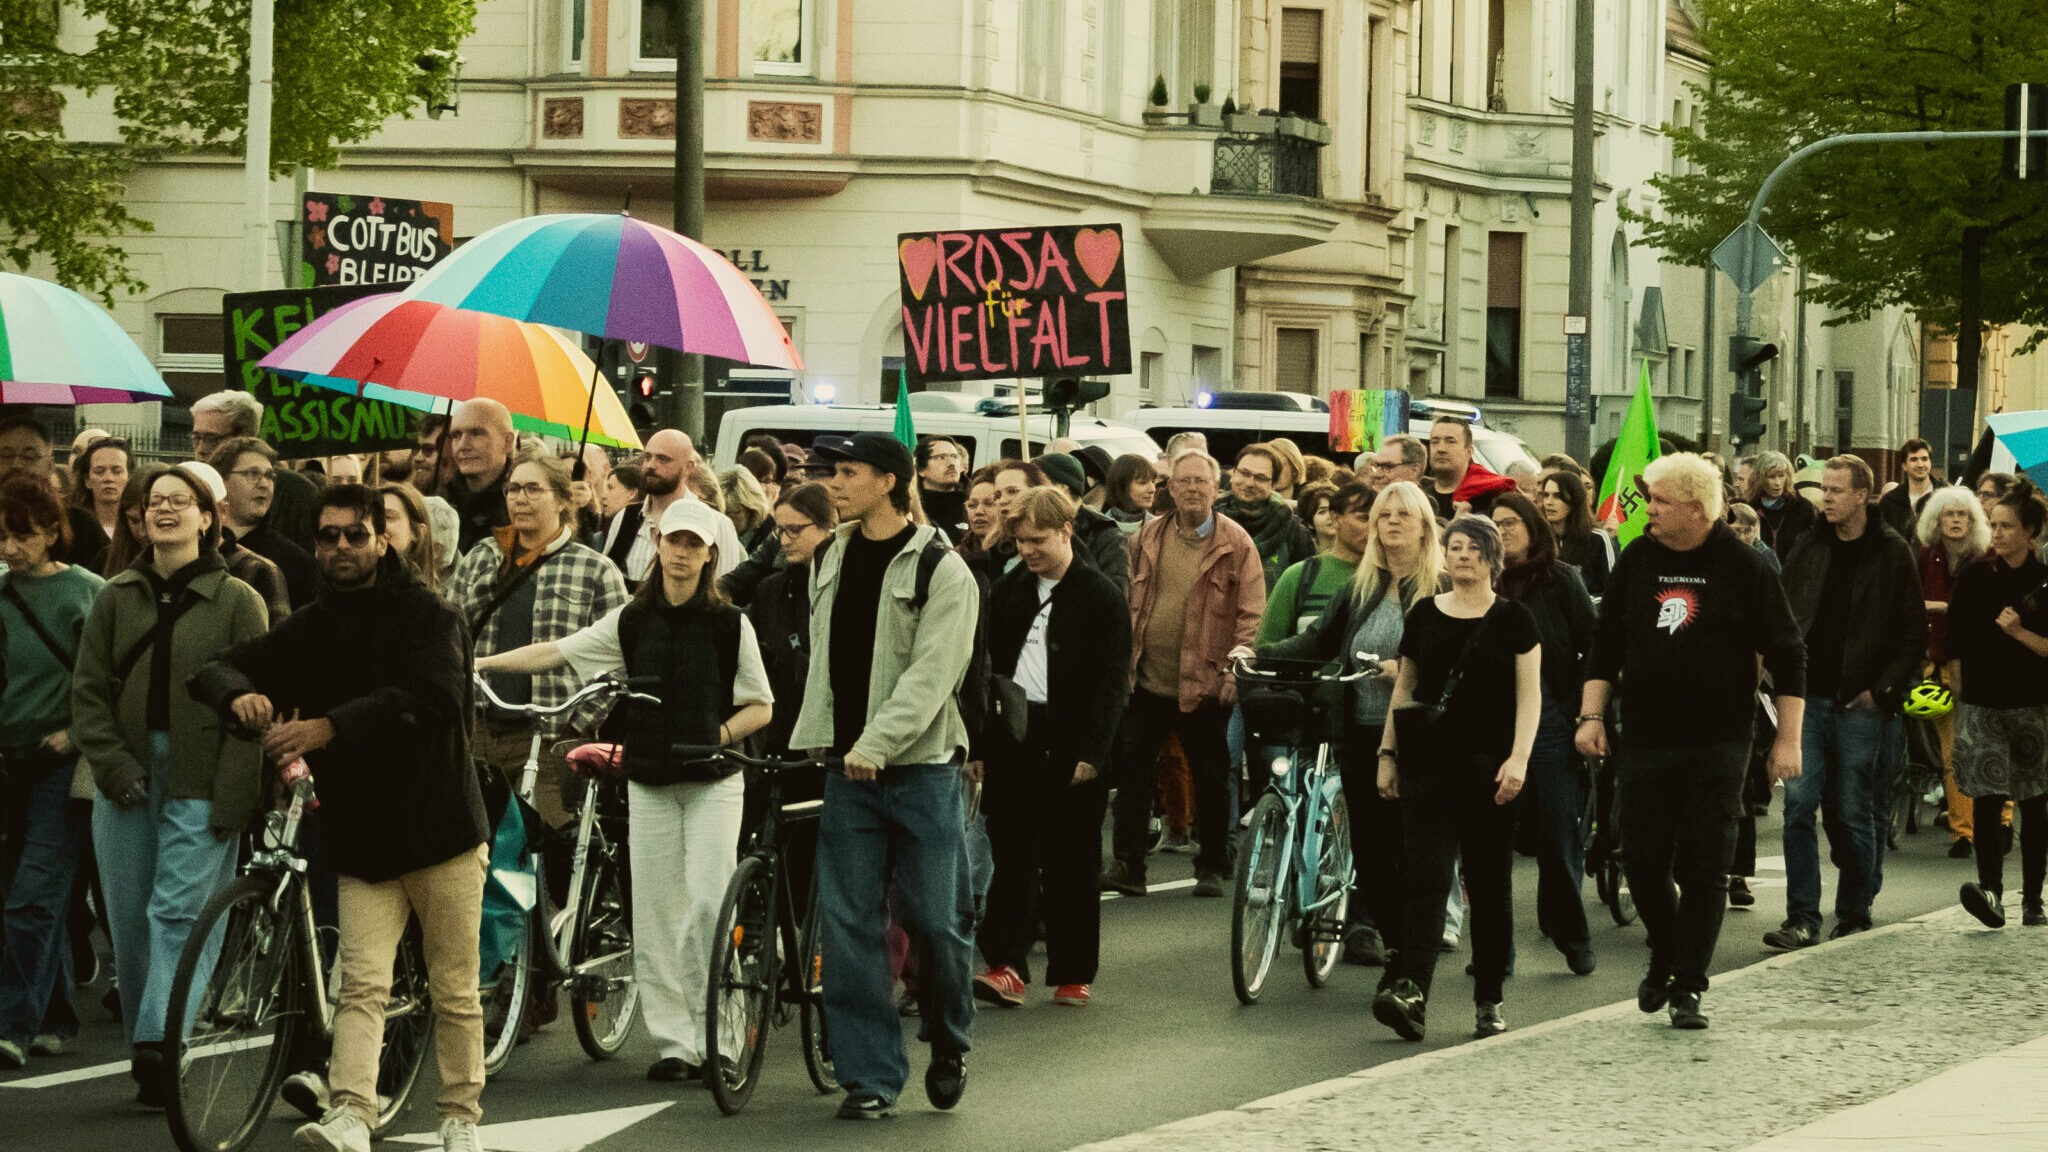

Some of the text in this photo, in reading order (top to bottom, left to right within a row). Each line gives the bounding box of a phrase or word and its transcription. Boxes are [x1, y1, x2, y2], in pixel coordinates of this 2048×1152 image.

[327, 214, 438, 262] COTTBUS
[712, 248, 769, 271] LL
[936, 231, 1077, 298] ROSA
[985, 279, 1026, 328] für
[903, 290, 1125, 374] VIELFALT
